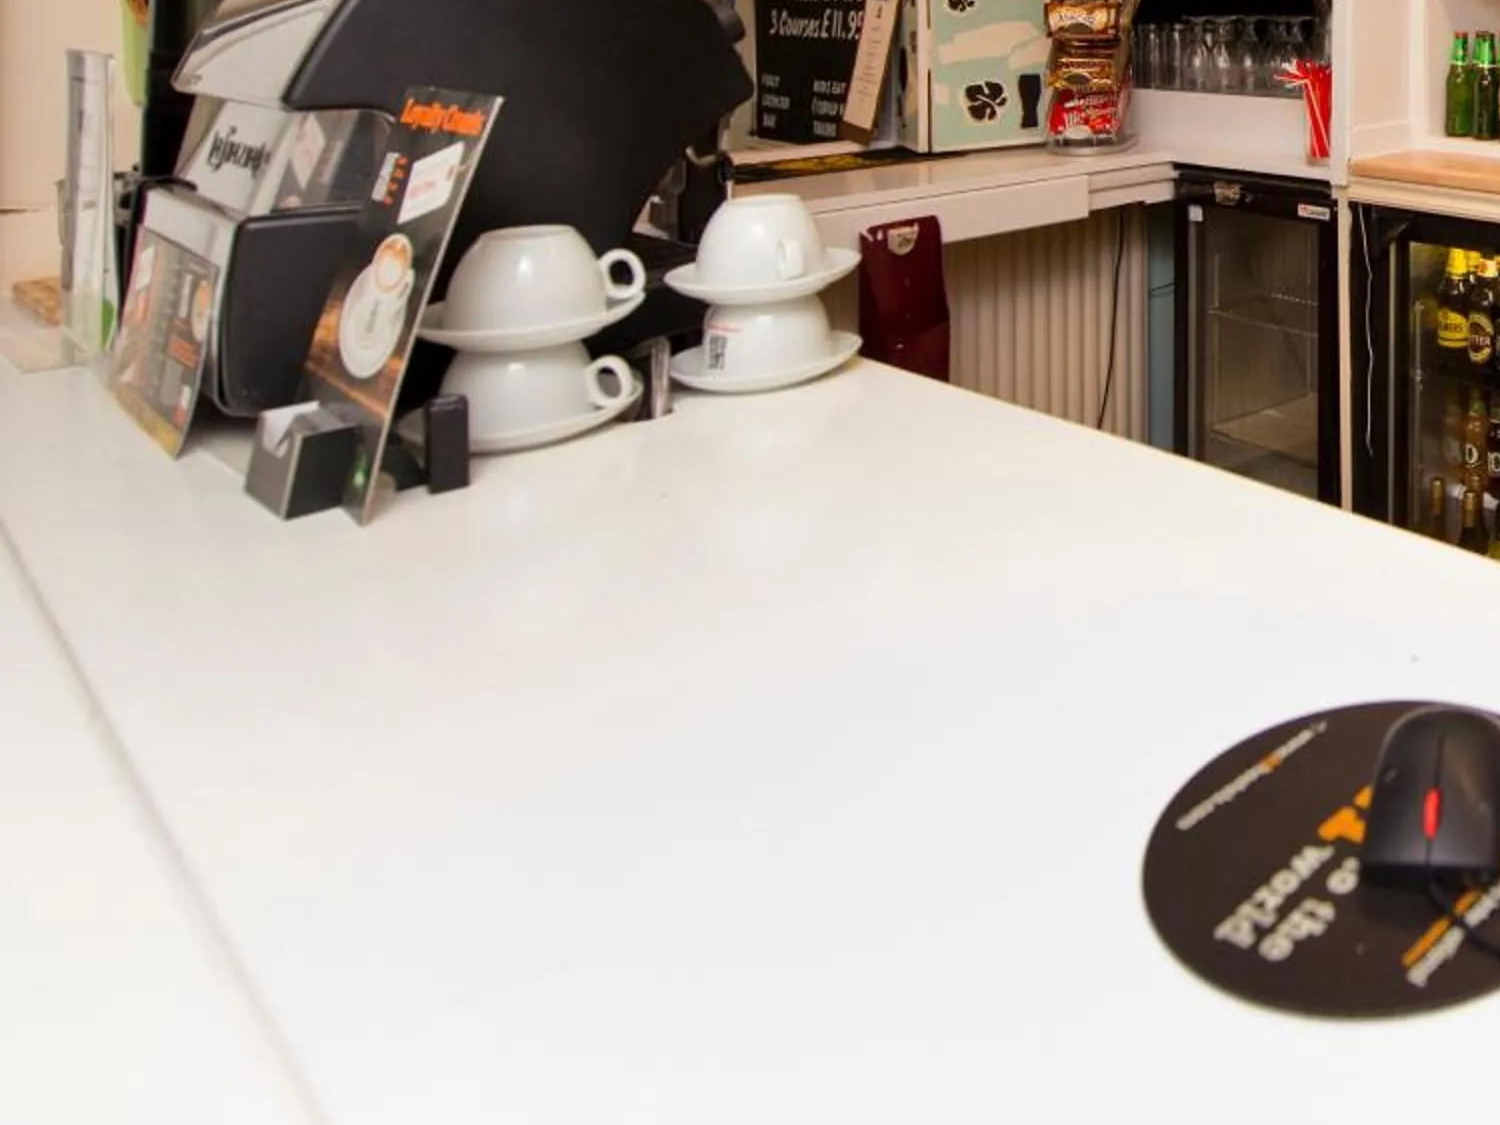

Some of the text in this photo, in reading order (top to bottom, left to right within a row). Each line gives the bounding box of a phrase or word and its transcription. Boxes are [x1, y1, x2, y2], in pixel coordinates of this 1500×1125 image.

[769, 9, 778, 35] 3
[779, 9, 820, 38] Courses
[1213, 845, 1335, 949] world
[1258, 899, 1336, 962] the
